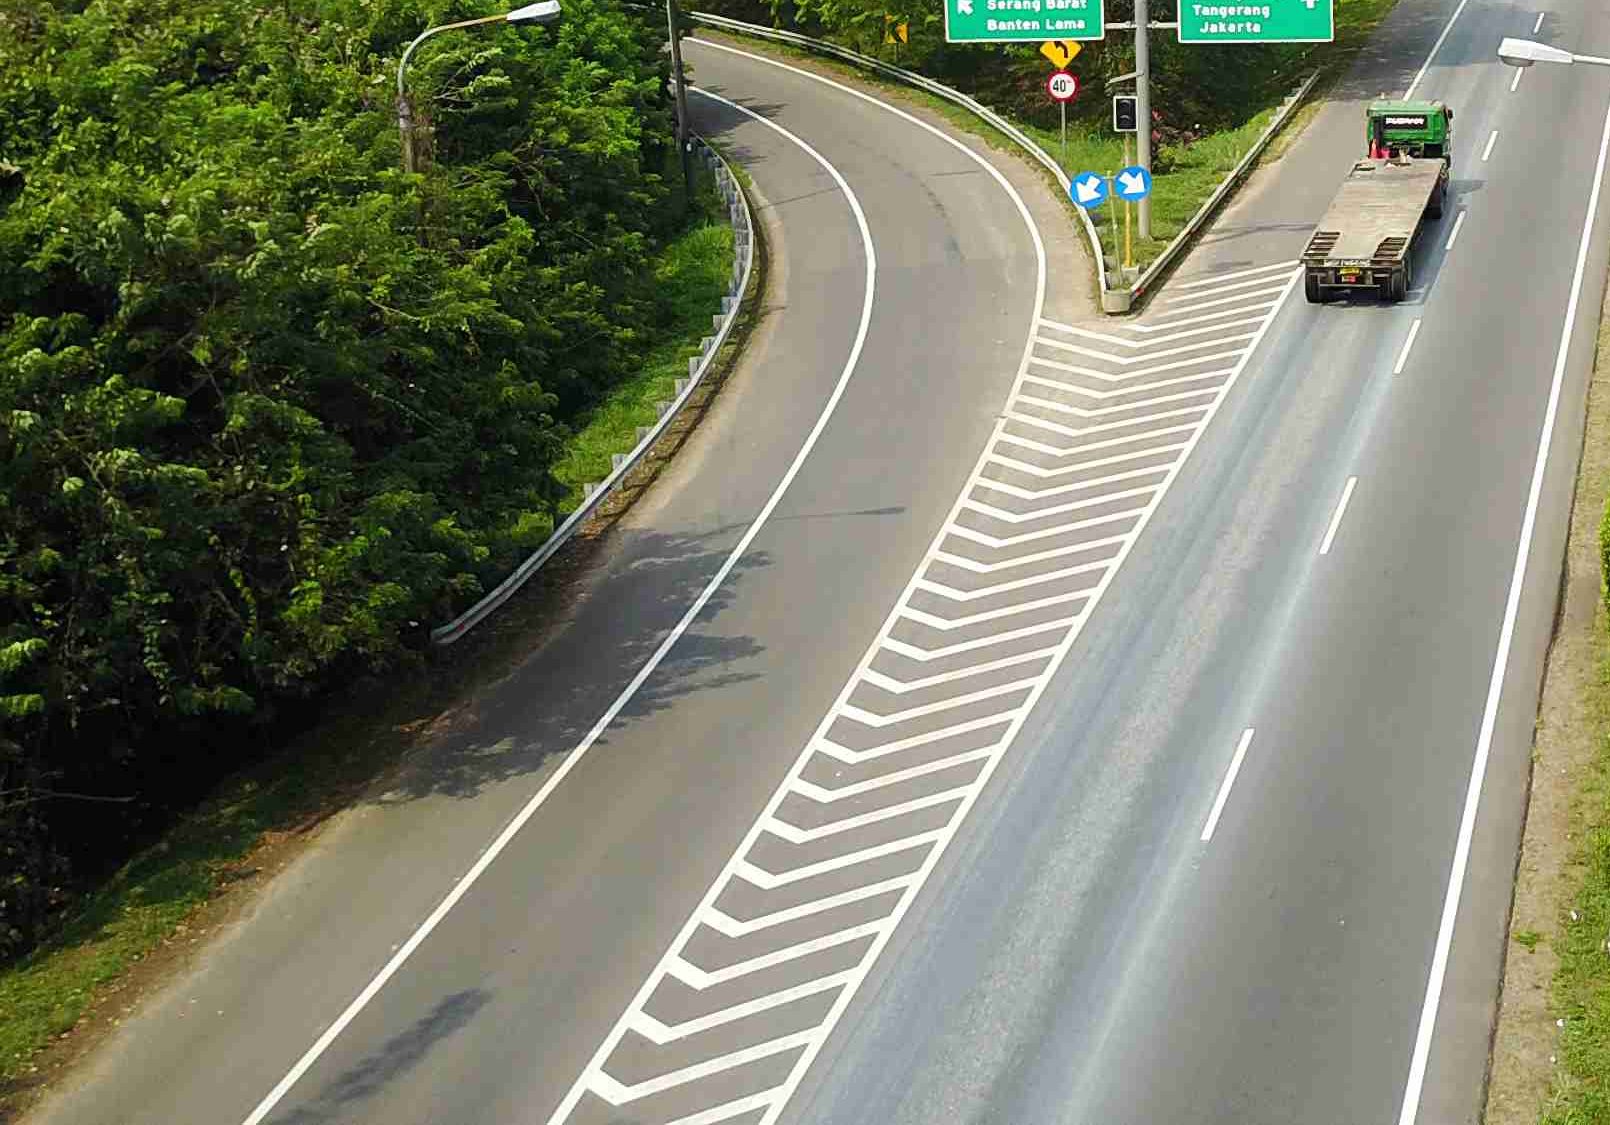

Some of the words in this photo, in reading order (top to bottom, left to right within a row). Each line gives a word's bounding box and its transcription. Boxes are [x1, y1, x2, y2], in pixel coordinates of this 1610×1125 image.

[1192, 4, 1270, 18] Tangerang
[987, 19, 1040, 31] Banten
[1045, 18, 1085, 30] Lama
[1199, 21, 1261, 34] Jakarta
[1052, 79, 1066, 93] 40
